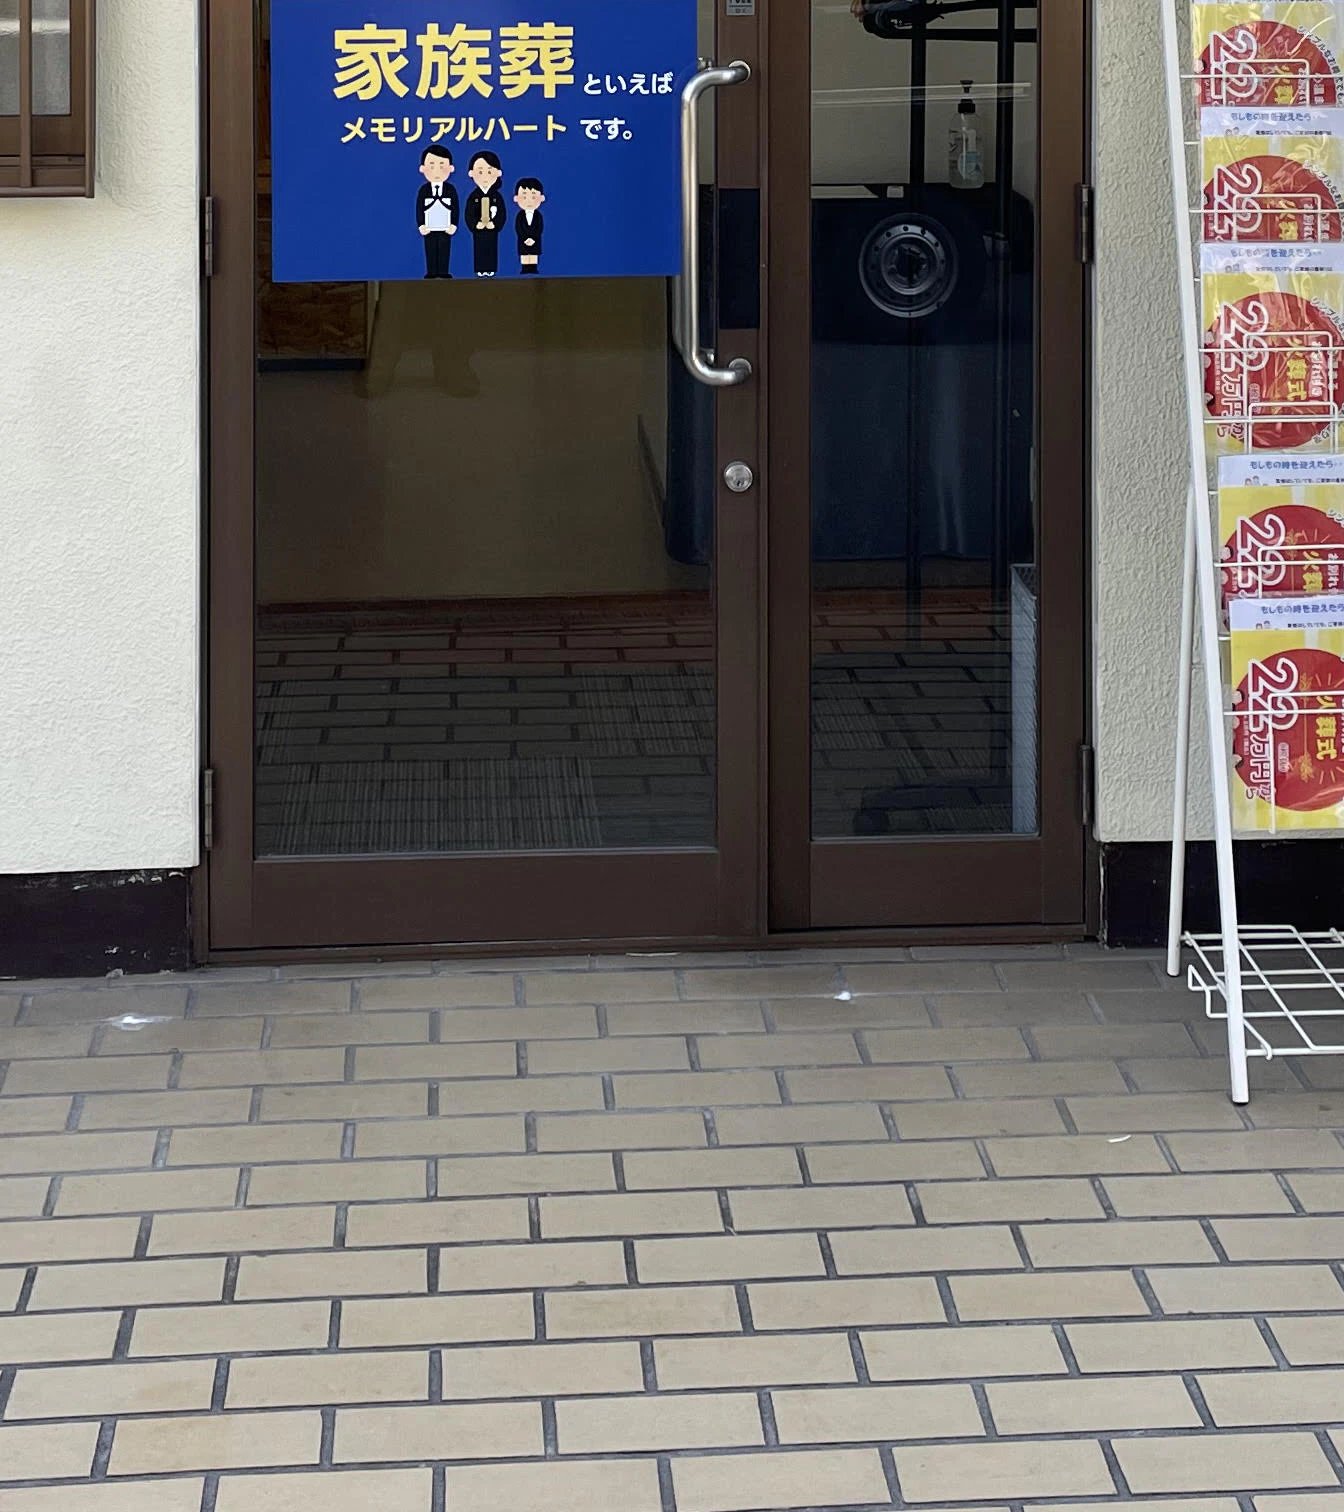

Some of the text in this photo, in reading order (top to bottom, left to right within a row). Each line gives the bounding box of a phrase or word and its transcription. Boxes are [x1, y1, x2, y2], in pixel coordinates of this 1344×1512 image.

[333, 22, 675, 101] 家族葬 といえば
[340, 114, 633, 144] メモリアルハート です。
